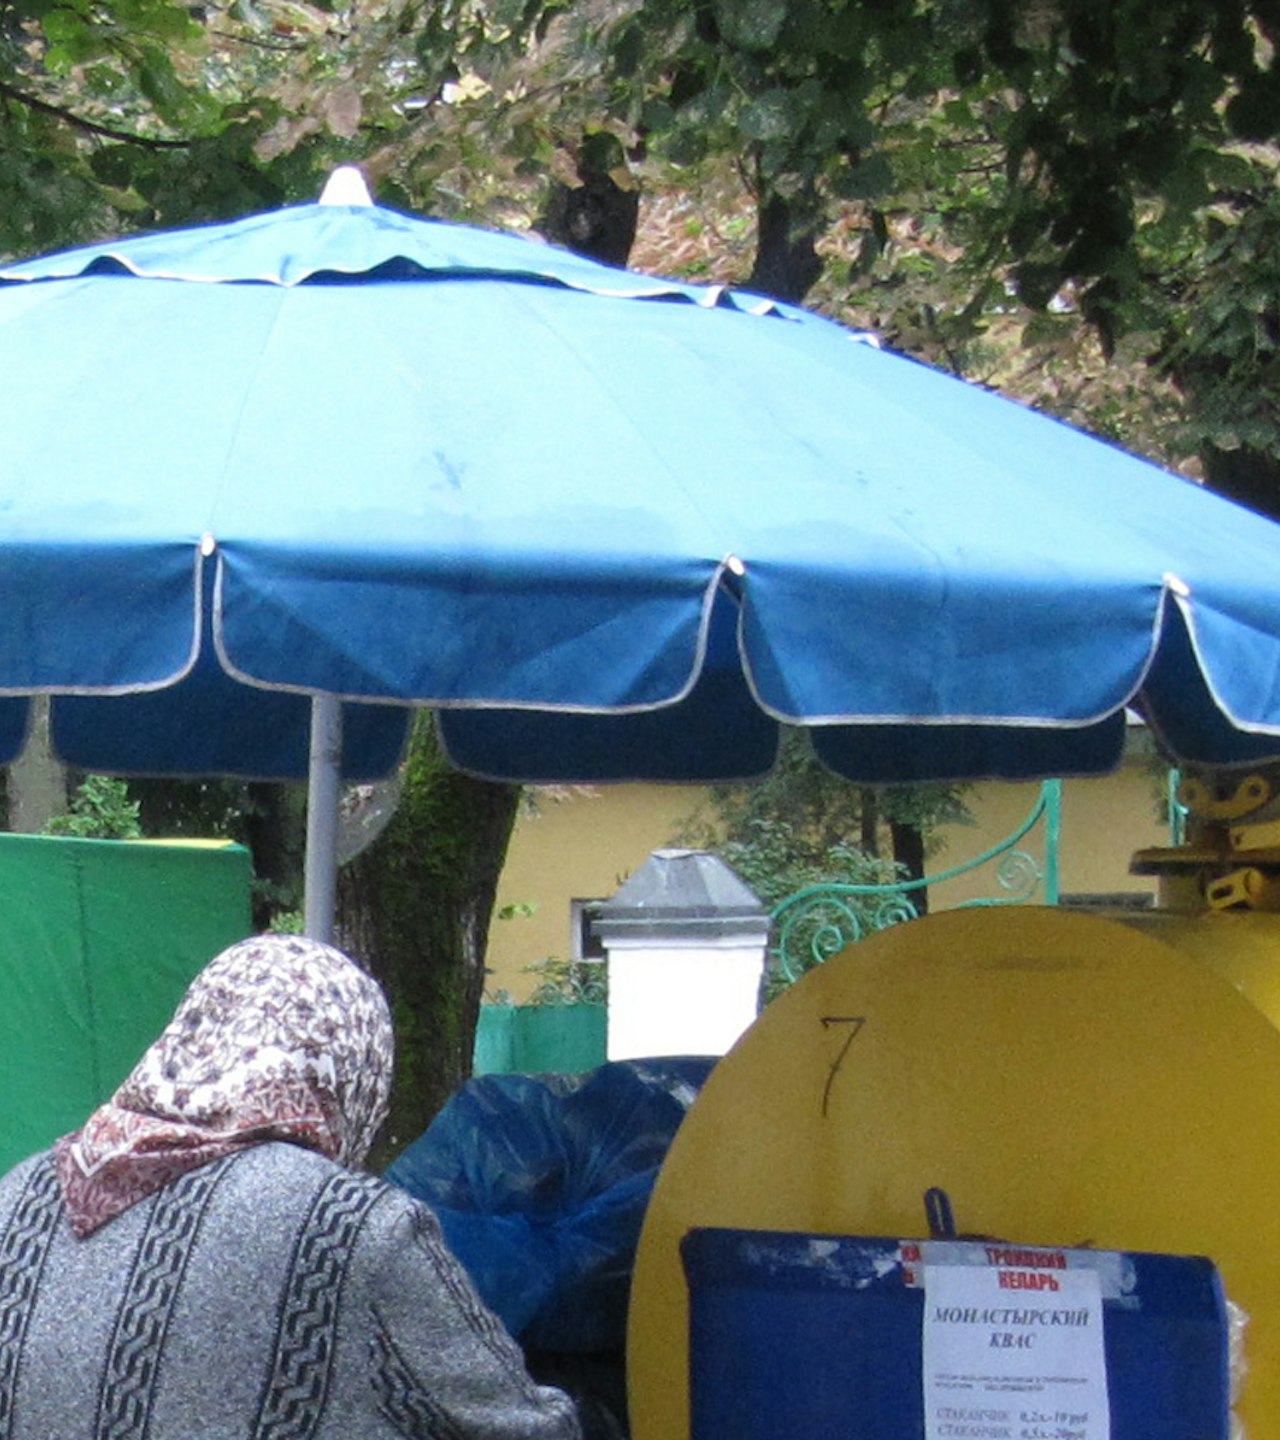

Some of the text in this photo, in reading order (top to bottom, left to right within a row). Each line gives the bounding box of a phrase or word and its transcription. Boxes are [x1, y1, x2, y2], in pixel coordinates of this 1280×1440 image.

[819, 1015, 866, 1118] 7
[985, 1247, 1067, 1270] ТРОИЦКИЙ
[998, 1270, 1060, 1292] КЕЛАРЬ
[932, 1306, 1090, 1328] МОНАСТЫРСКИЙ
[988, 1332, 1038, 1350] КВАС
